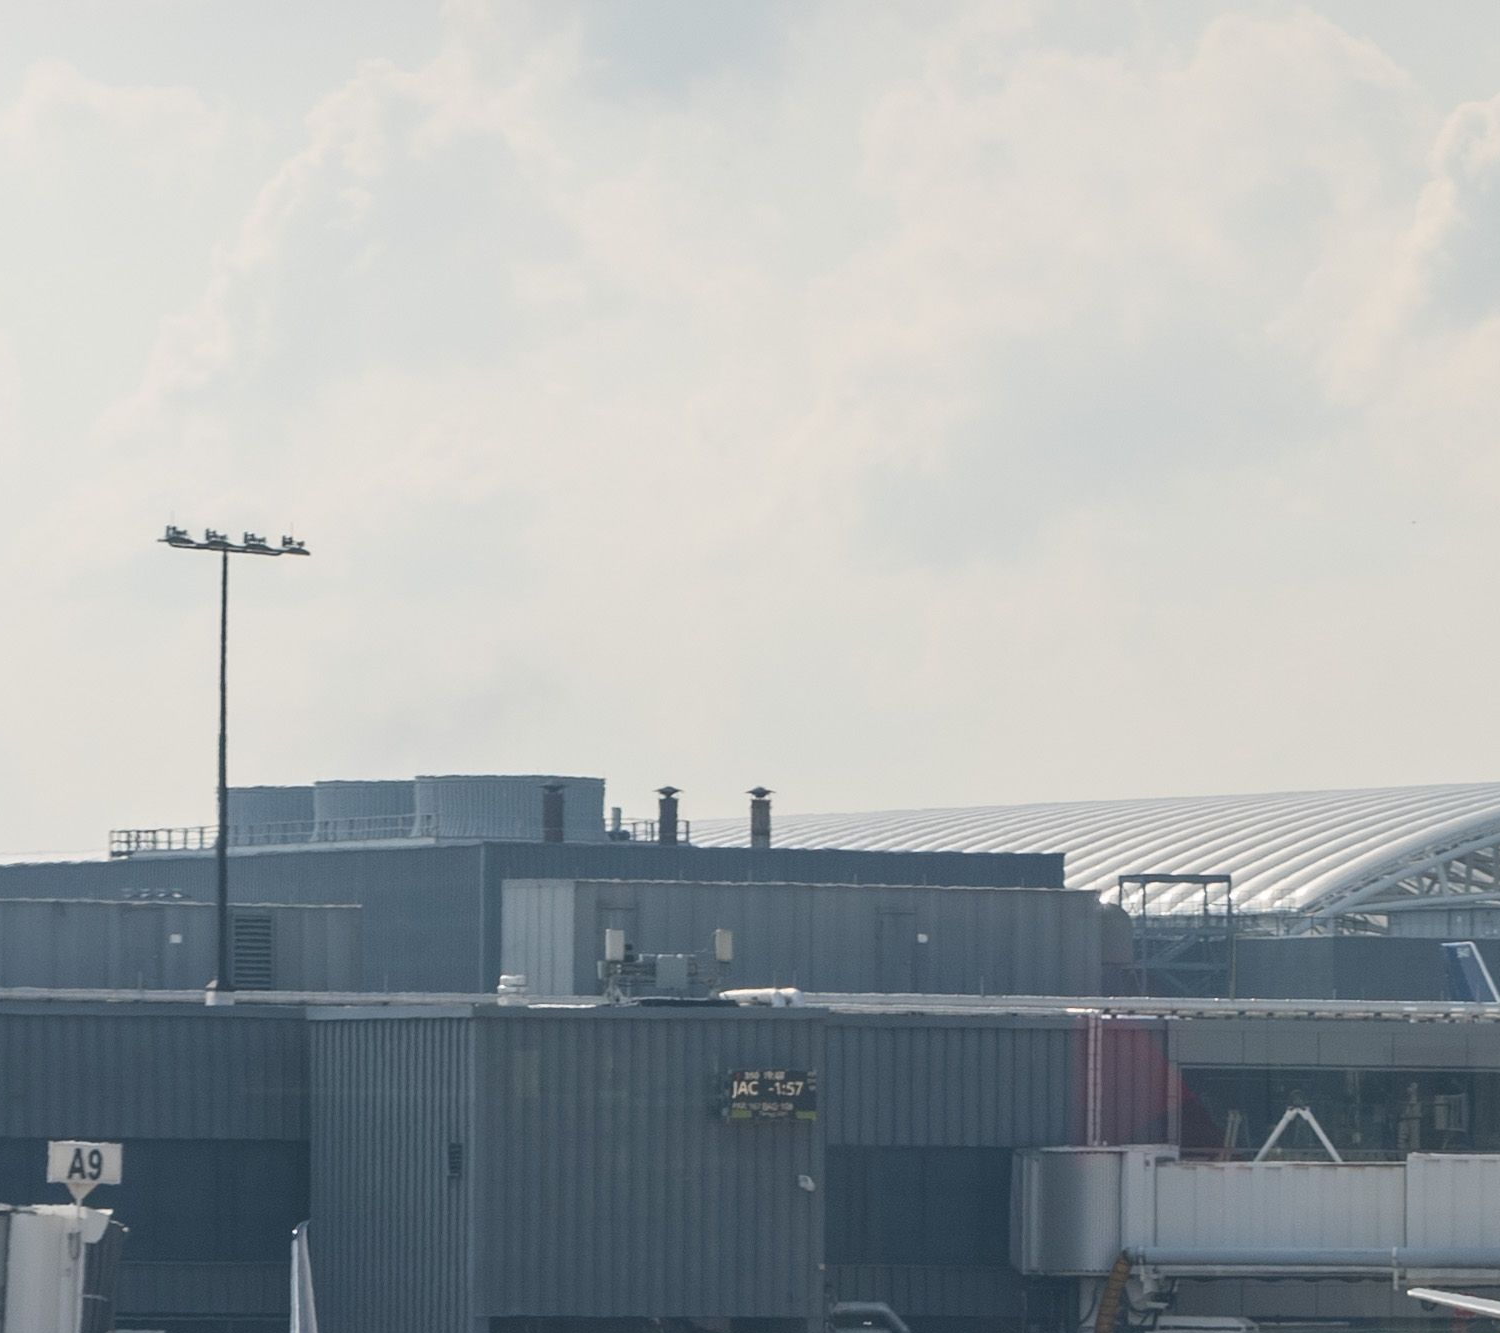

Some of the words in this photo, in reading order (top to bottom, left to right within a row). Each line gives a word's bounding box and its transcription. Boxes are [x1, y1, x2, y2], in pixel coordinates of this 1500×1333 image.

[732, 1081, 759, 1098] JAC
[768, 1081, 804, 1096] -1:57
[67, 1148, 103, 1180] A9
